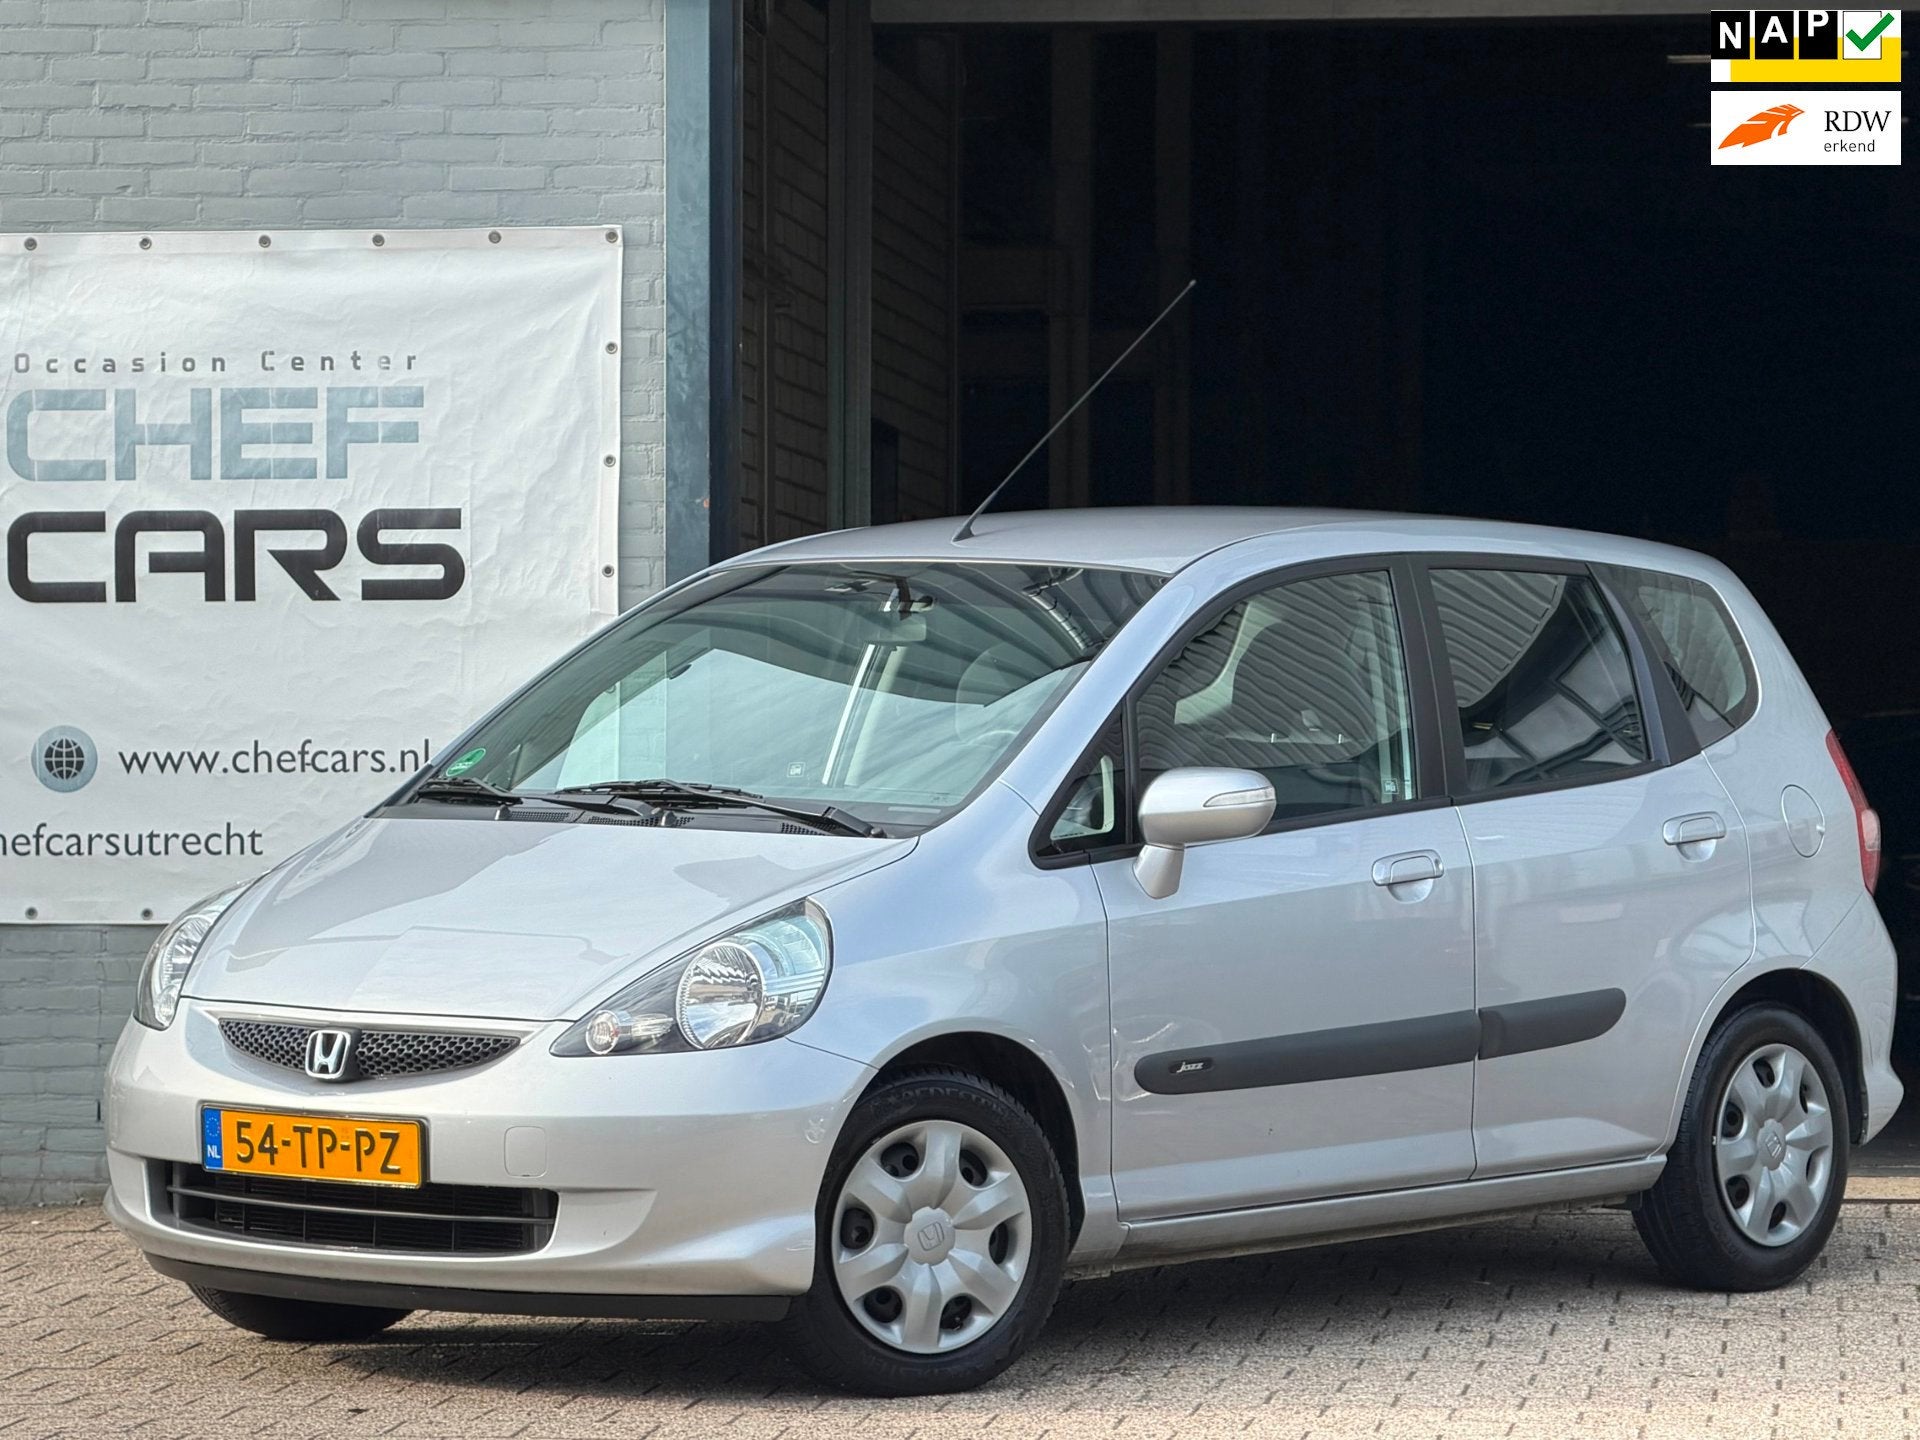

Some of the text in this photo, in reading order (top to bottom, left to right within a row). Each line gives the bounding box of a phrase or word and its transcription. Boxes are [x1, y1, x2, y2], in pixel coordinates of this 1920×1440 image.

[14, 350, 417, 374] Occasion Center
[7, 386, 425, 482] CHEF
[7, 507, 466, 604] CARS
[118, 738, 430, 774] www.chefcars.nl
[207, 1144, 222, 1160] NL
[236, 1120, 402, 1175] 54-TP-PZ
